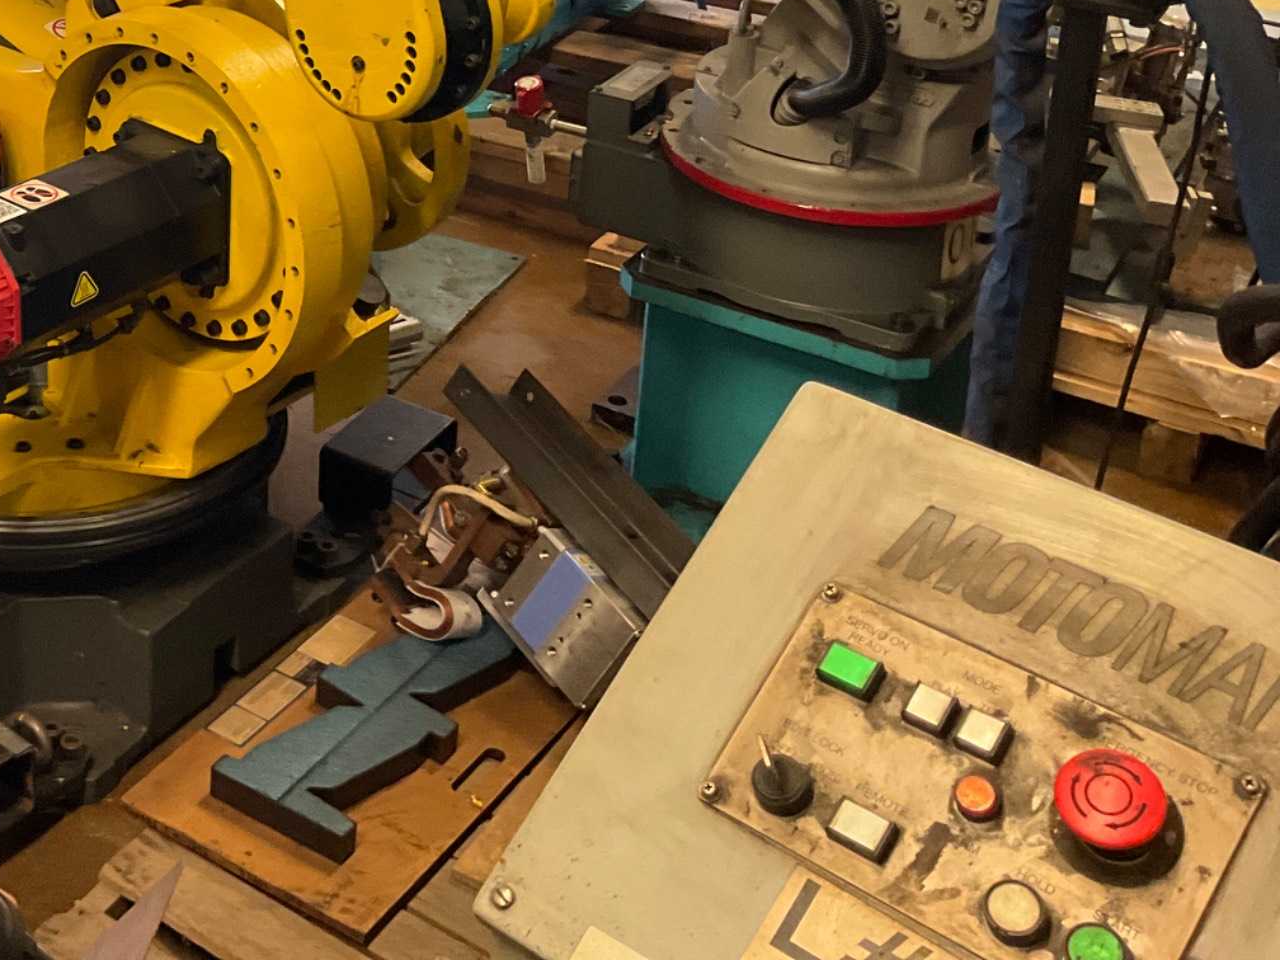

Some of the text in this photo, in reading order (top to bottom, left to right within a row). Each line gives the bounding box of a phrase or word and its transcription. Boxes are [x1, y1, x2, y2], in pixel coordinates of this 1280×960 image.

[890, 633, 911, 652] ON
[962, 669, 1001, 695] MODE
[1015, 867, 1057, 897] HOLD
